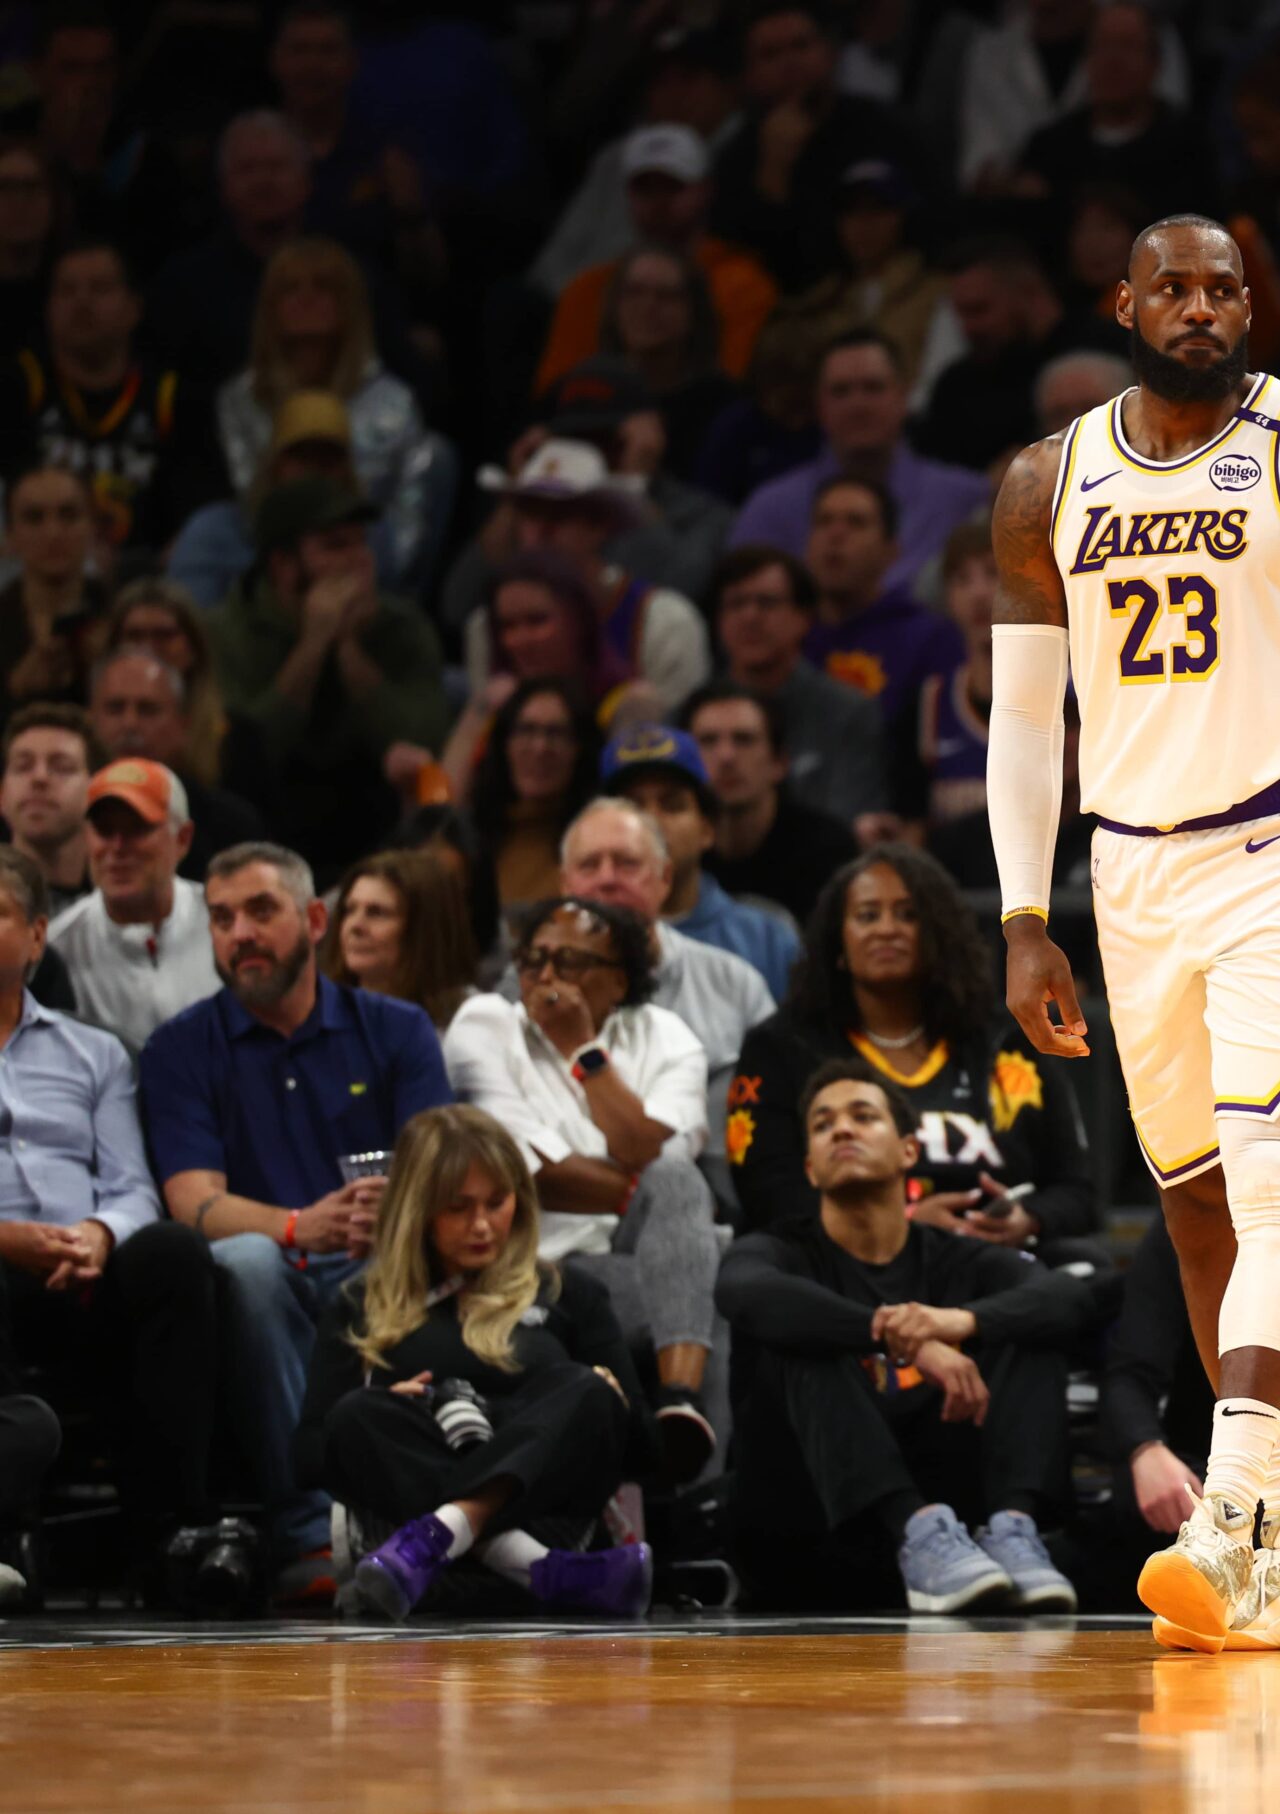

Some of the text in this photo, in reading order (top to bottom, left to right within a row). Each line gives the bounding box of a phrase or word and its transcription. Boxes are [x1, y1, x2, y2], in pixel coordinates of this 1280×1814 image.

[1255, 414, 1270, 427] 44
[1214, 463, 1259, 481] bibigo
[1069, 503, 1250, 578] LAKERS
[1105, 573, 1220, 686] 23
